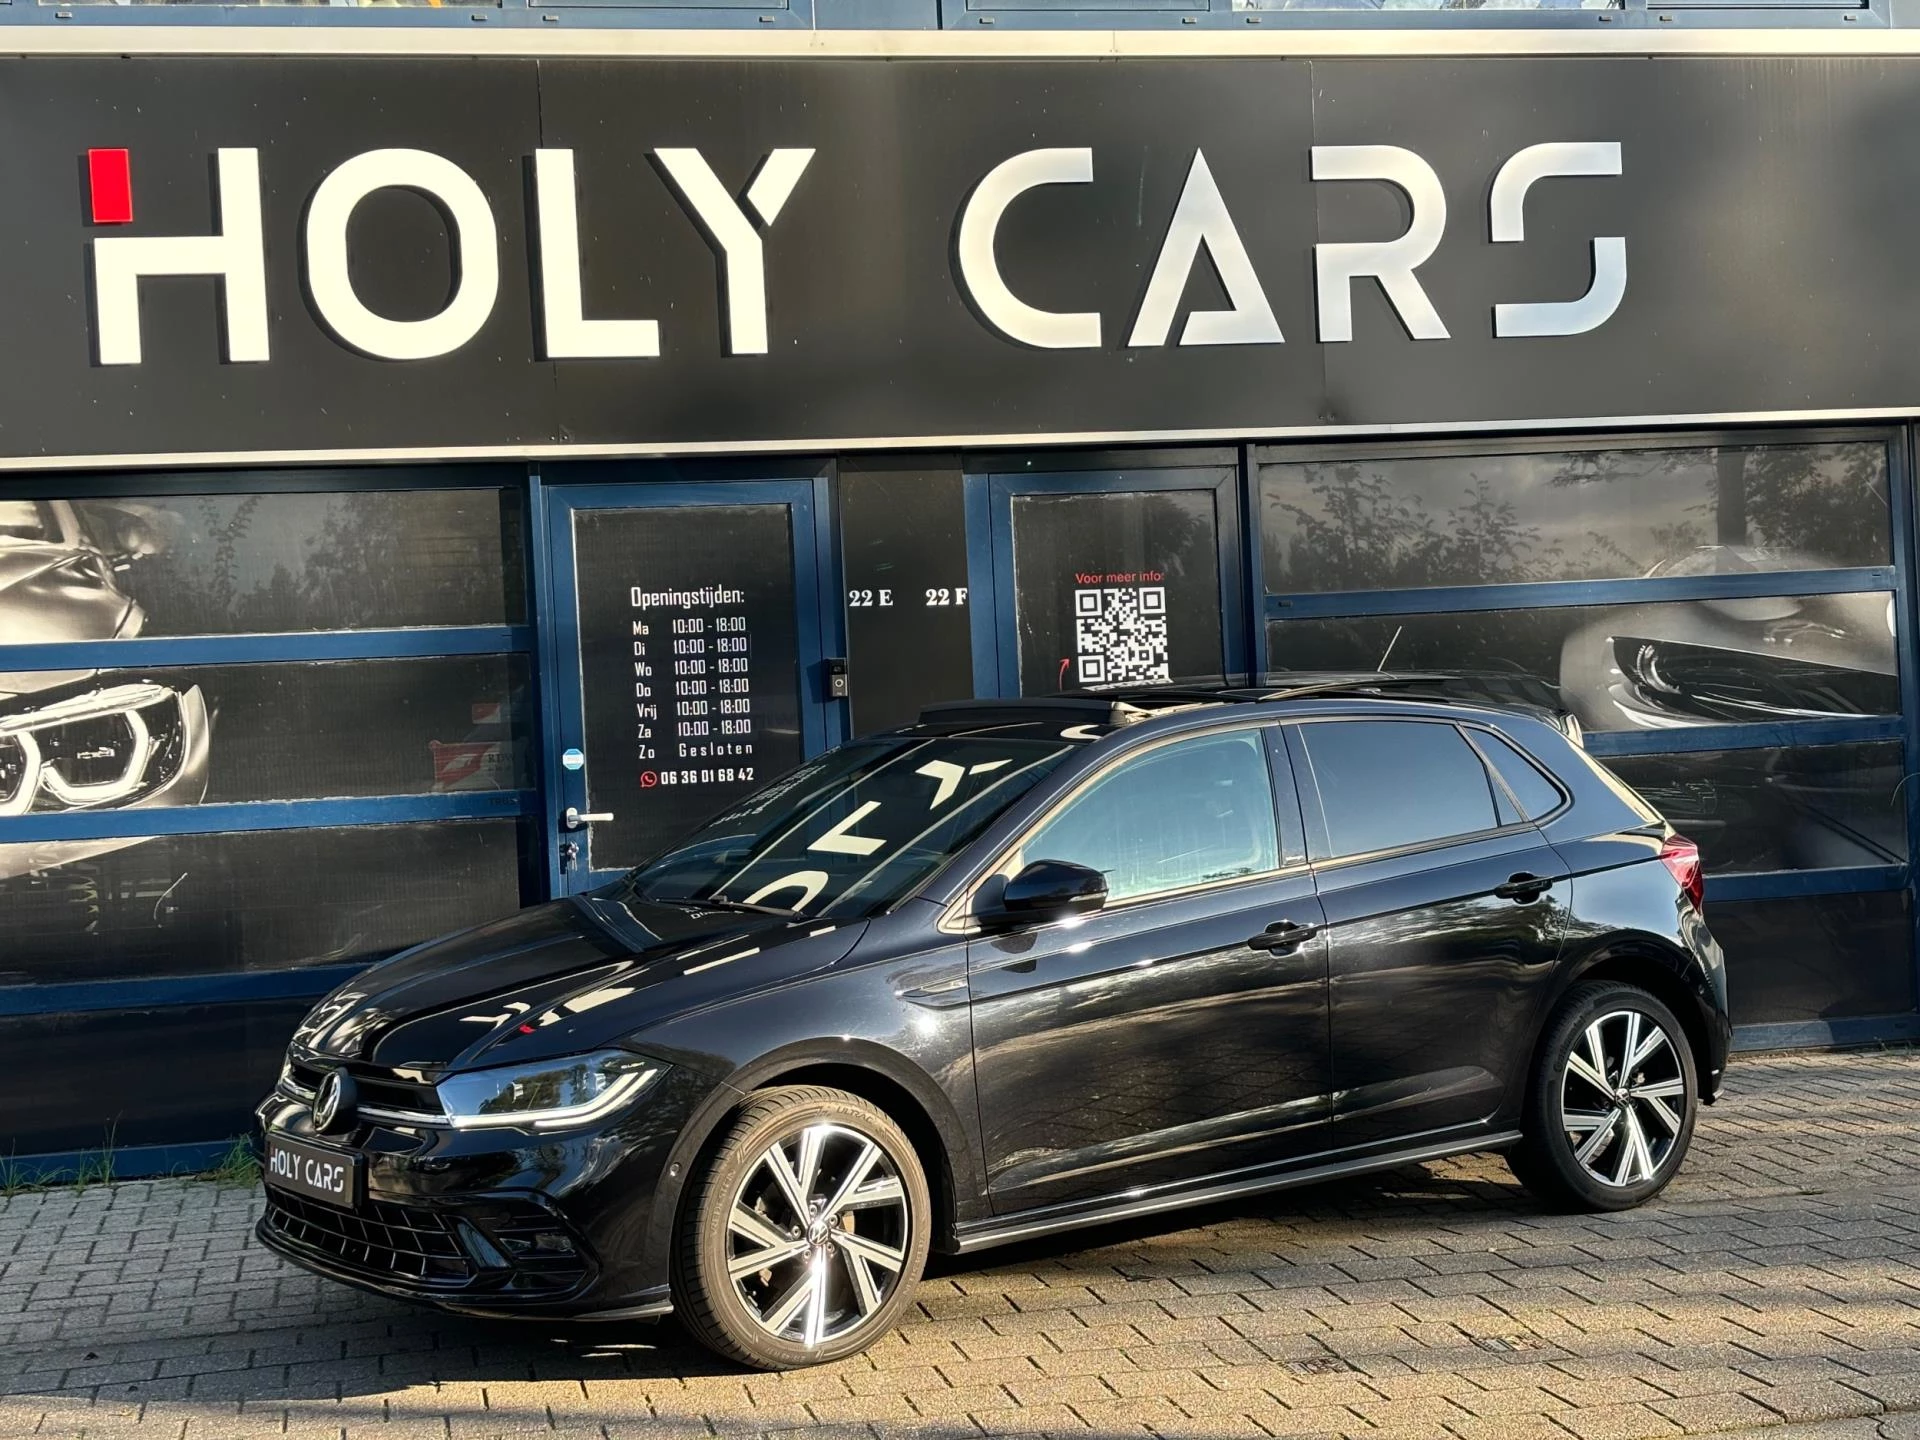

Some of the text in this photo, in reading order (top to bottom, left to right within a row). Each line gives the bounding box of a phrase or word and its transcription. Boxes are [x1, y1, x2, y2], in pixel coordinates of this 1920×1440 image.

[88, 130, 1627, 365] HOLY CARS
[1075, 570, 1165, 584] Voor meer info:
[631, 584, 745, 610] Openingstijden:
[849, 590, 893, 606] 22 E
[926, 588, 967, 605] 22 F
[633, 621, 648, 635] Ma
[673, 619, 703, 633] 10:00
[716, 617, 745, 631] 18:00
[634, 642, 645, 655] Di
[674, 639, 704, 654] 10:00
[718, 638, 746, 652] 18:00
[635, 662, 651, 676] Wo
[675, 660, 705, 674] 10:00
[719, 658, 748, 672] 18:00
[636, 683, 651, 697] Do
[676, 681, 706, 695] 10:00
[720, 679, 749, 693] 18:00
[637, 704, 656, 720] Vrij
[677, 701, 707, 715] 10:00
[721, 699, 750, 713] 18:00
[639, 724, 651, 738] Za
[679, 721, 708, 736] 10:00
[722, 719, 750, 734] 18:00
[640, 742, 752, 759] Zo Gesloten
[661, 768, 753, 784] 06 36 01 68 42
[270, 1144, 344, 1193] HOLY CARS
